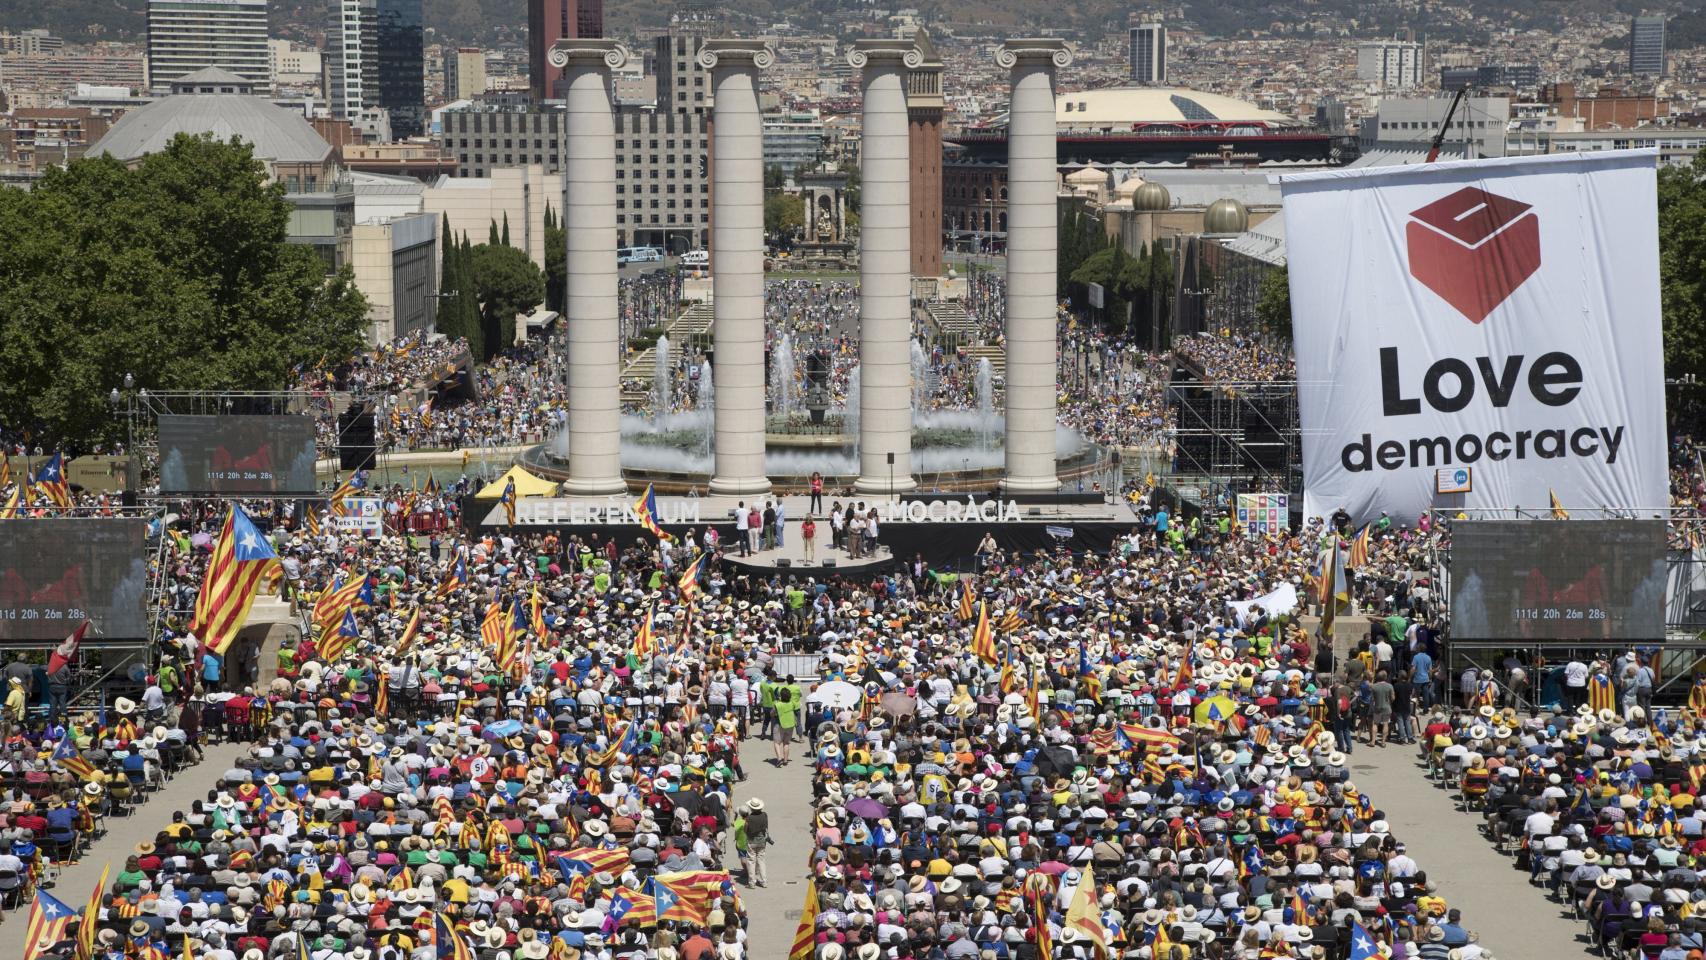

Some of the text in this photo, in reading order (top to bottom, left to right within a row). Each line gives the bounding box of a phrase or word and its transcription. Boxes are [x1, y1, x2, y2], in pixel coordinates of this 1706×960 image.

[1379, 346, 1583, 416] Love
[1341, 425, 1624, 472] democracy
[517, 495, 1022, 524] REFERÈNUM MOCRÀCIA
[21, 608, 39, 619] 20h
[44, 608, 63, 619] 26m
[67, 608, 85, 619] 28s
[1515, 608, 1606, 619] 111d 20h 26m 28s
